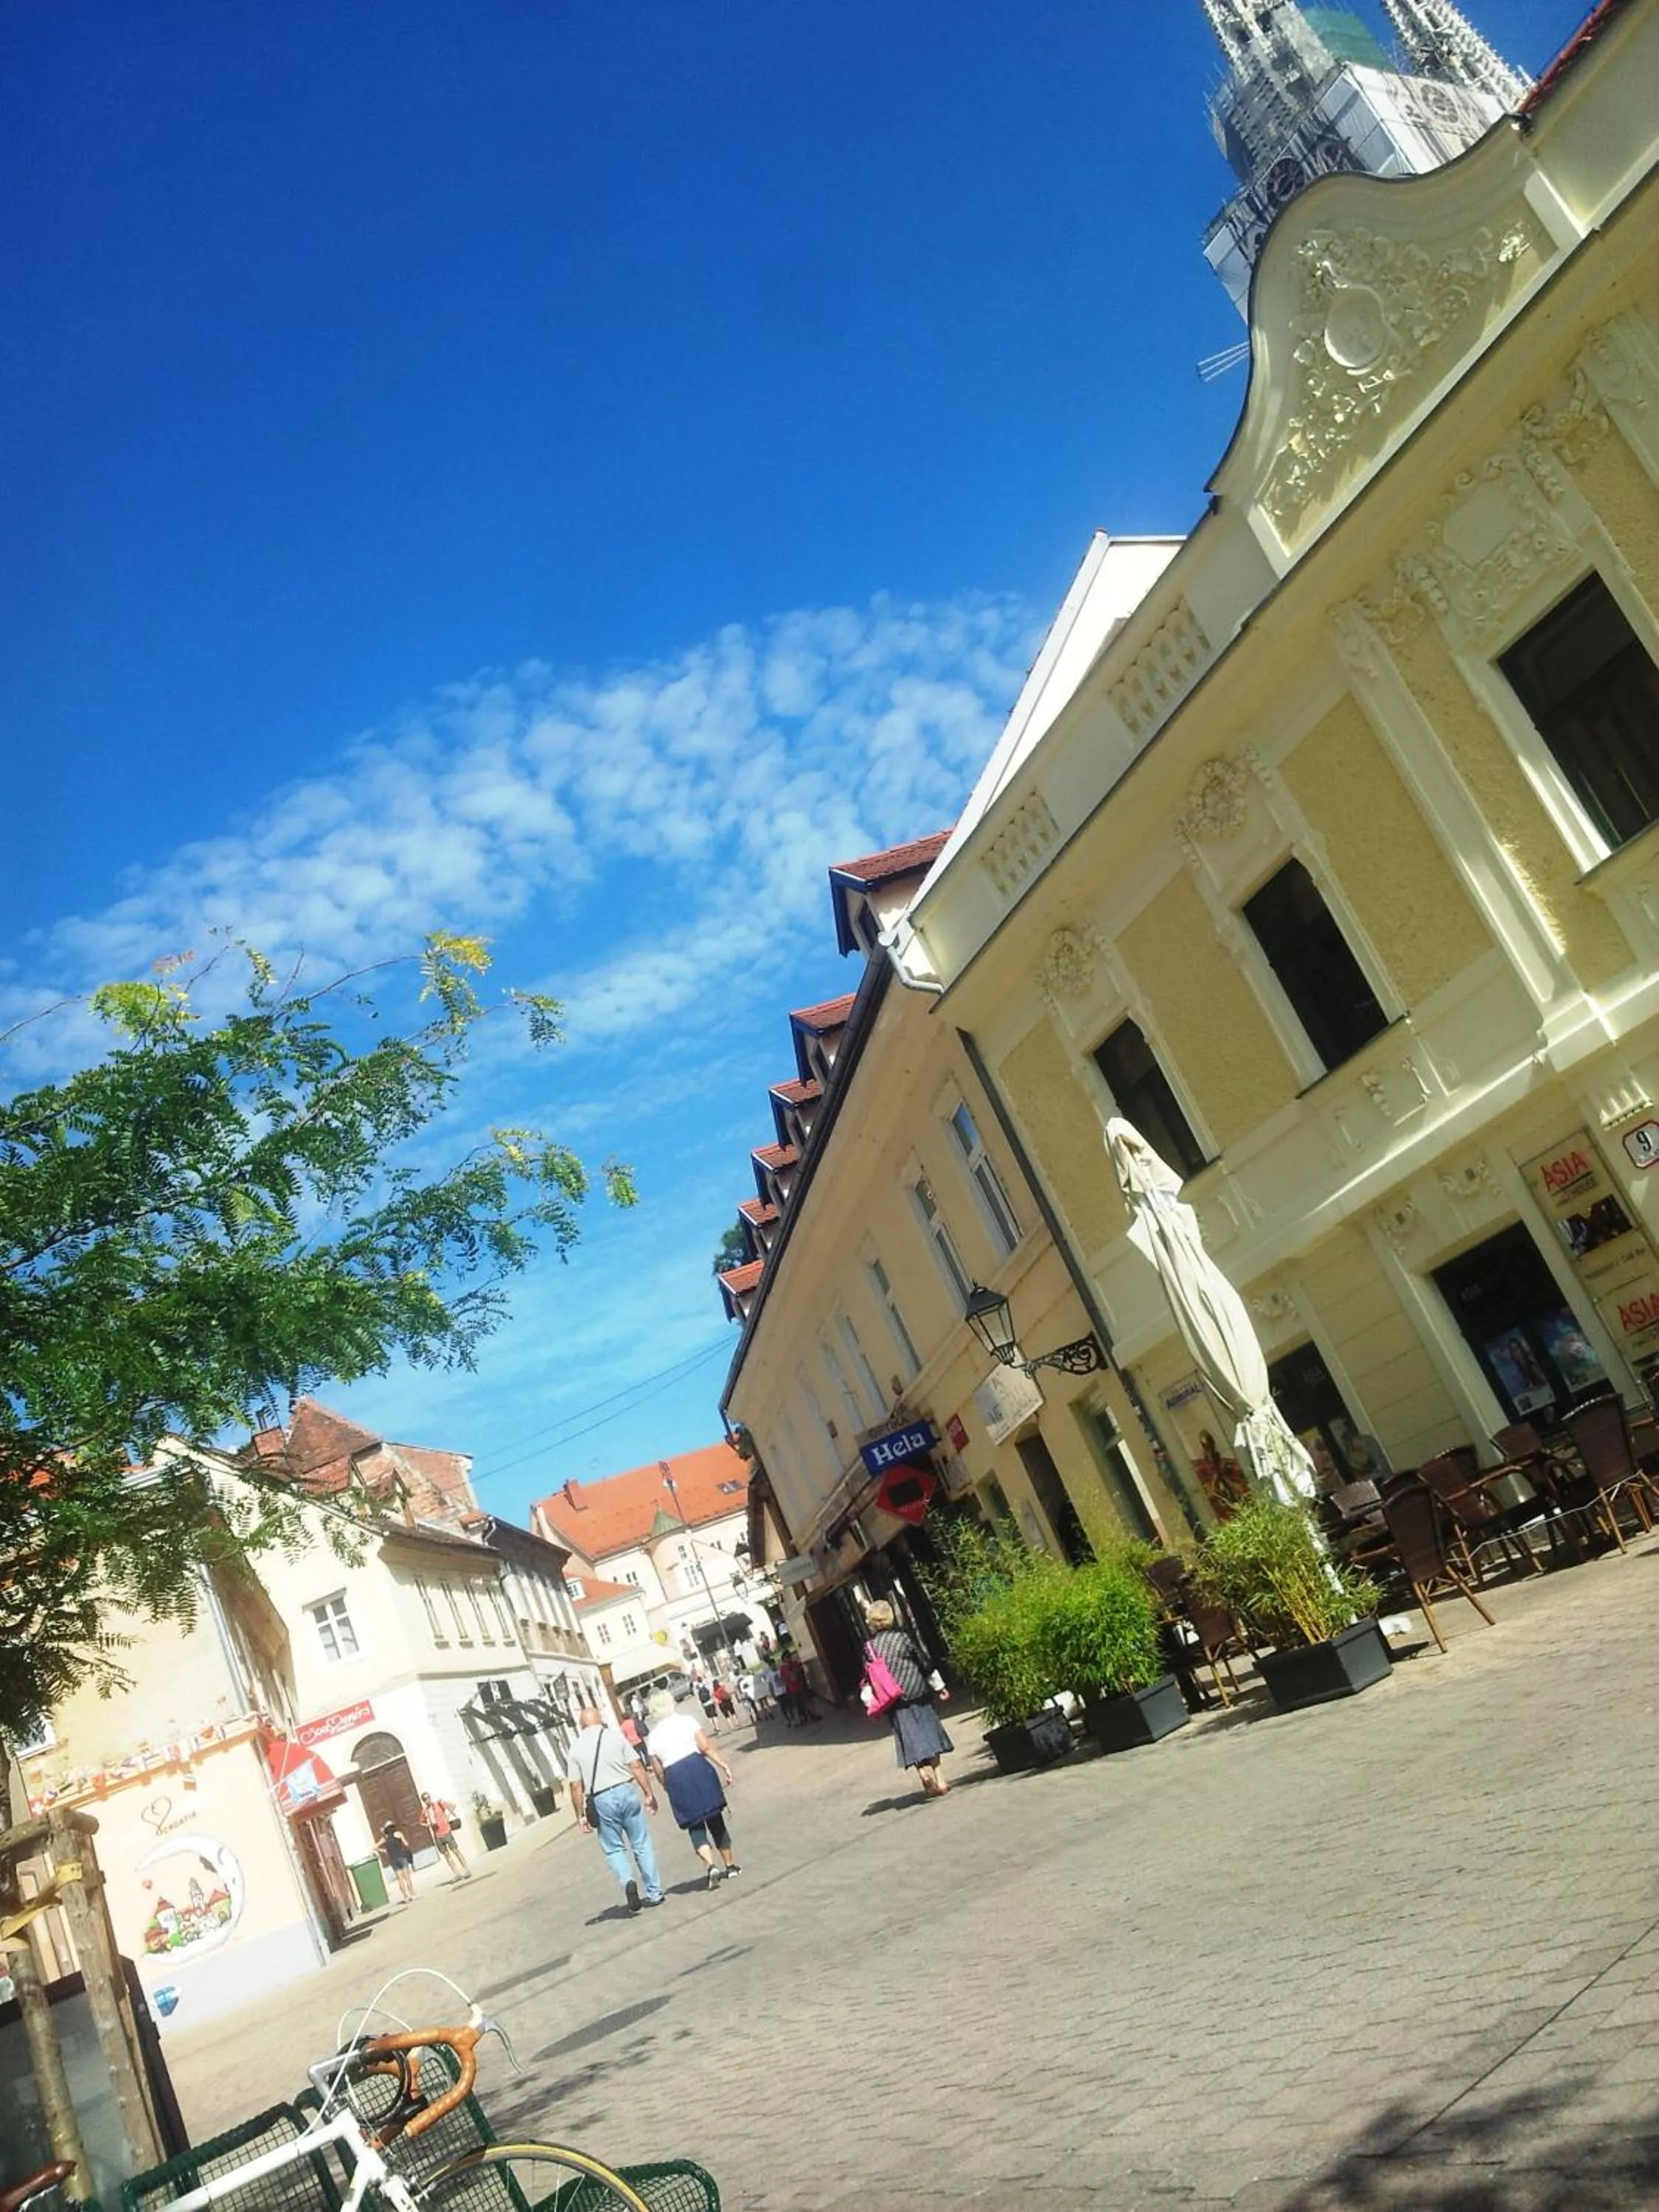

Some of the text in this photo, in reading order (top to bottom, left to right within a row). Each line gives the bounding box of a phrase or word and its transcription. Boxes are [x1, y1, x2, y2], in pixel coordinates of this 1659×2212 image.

[1636, 1131, 1651, 1152] 9
[1540, 1151, 1589, 1193] ASIA
[871, 1433, 927, 1466] Hela
